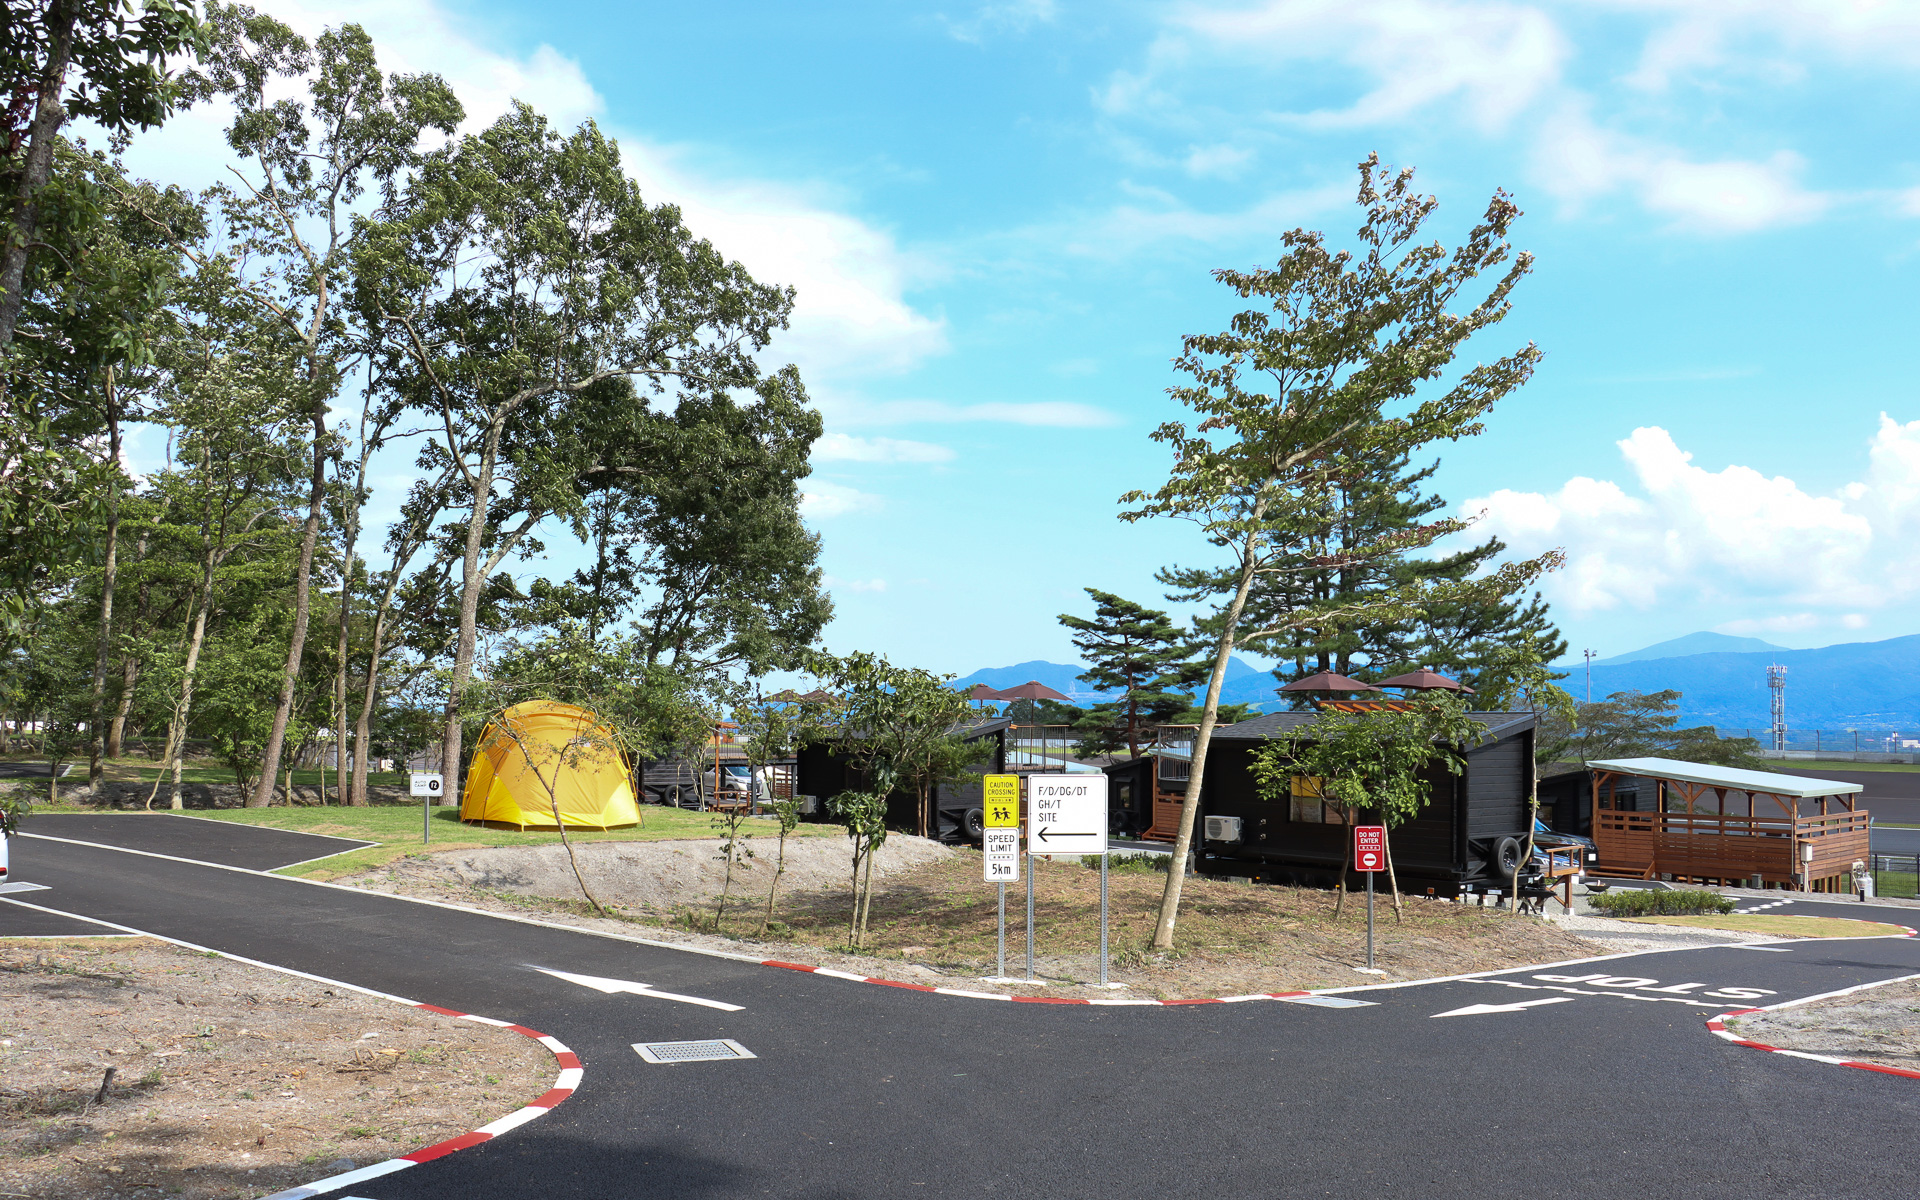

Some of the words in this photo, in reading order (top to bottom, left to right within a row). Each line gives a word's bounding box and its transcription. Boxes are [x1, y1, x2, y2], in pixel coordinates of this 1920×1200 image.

[1038, 786, 1088, 796] F/D/DG/DT
[1038, 800, 1061, 809] GH/T
[1038, 813, 1057, 822] SITE
[988, 835, 1015, 843] SPEED
[990, 844, 1012, 852] LIMIT
[992, 863, 1011, 875] 5km
[1531, 973, 1778, 999] STOP
